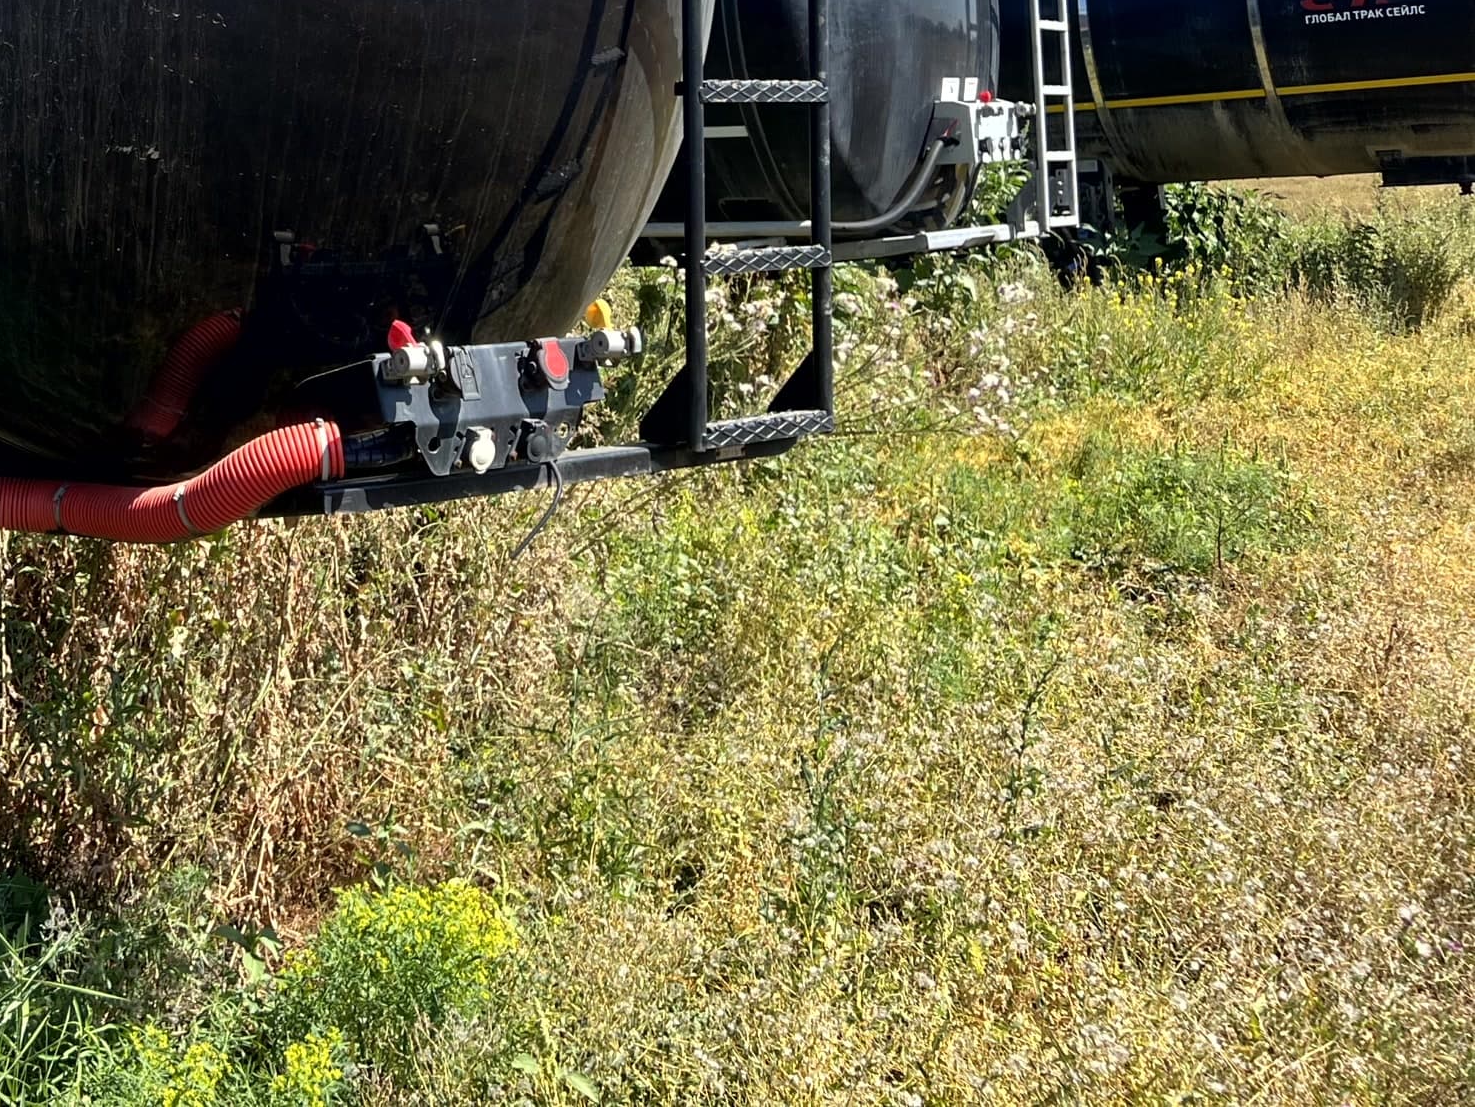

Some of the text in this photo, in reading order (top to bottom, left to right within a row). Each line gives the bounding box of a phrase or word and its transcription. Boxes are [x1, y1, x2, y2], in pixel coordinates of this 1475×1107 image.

[1304, 4, 1426, 25] ГЛОБАЛ ТРАК СЕЙЛС
